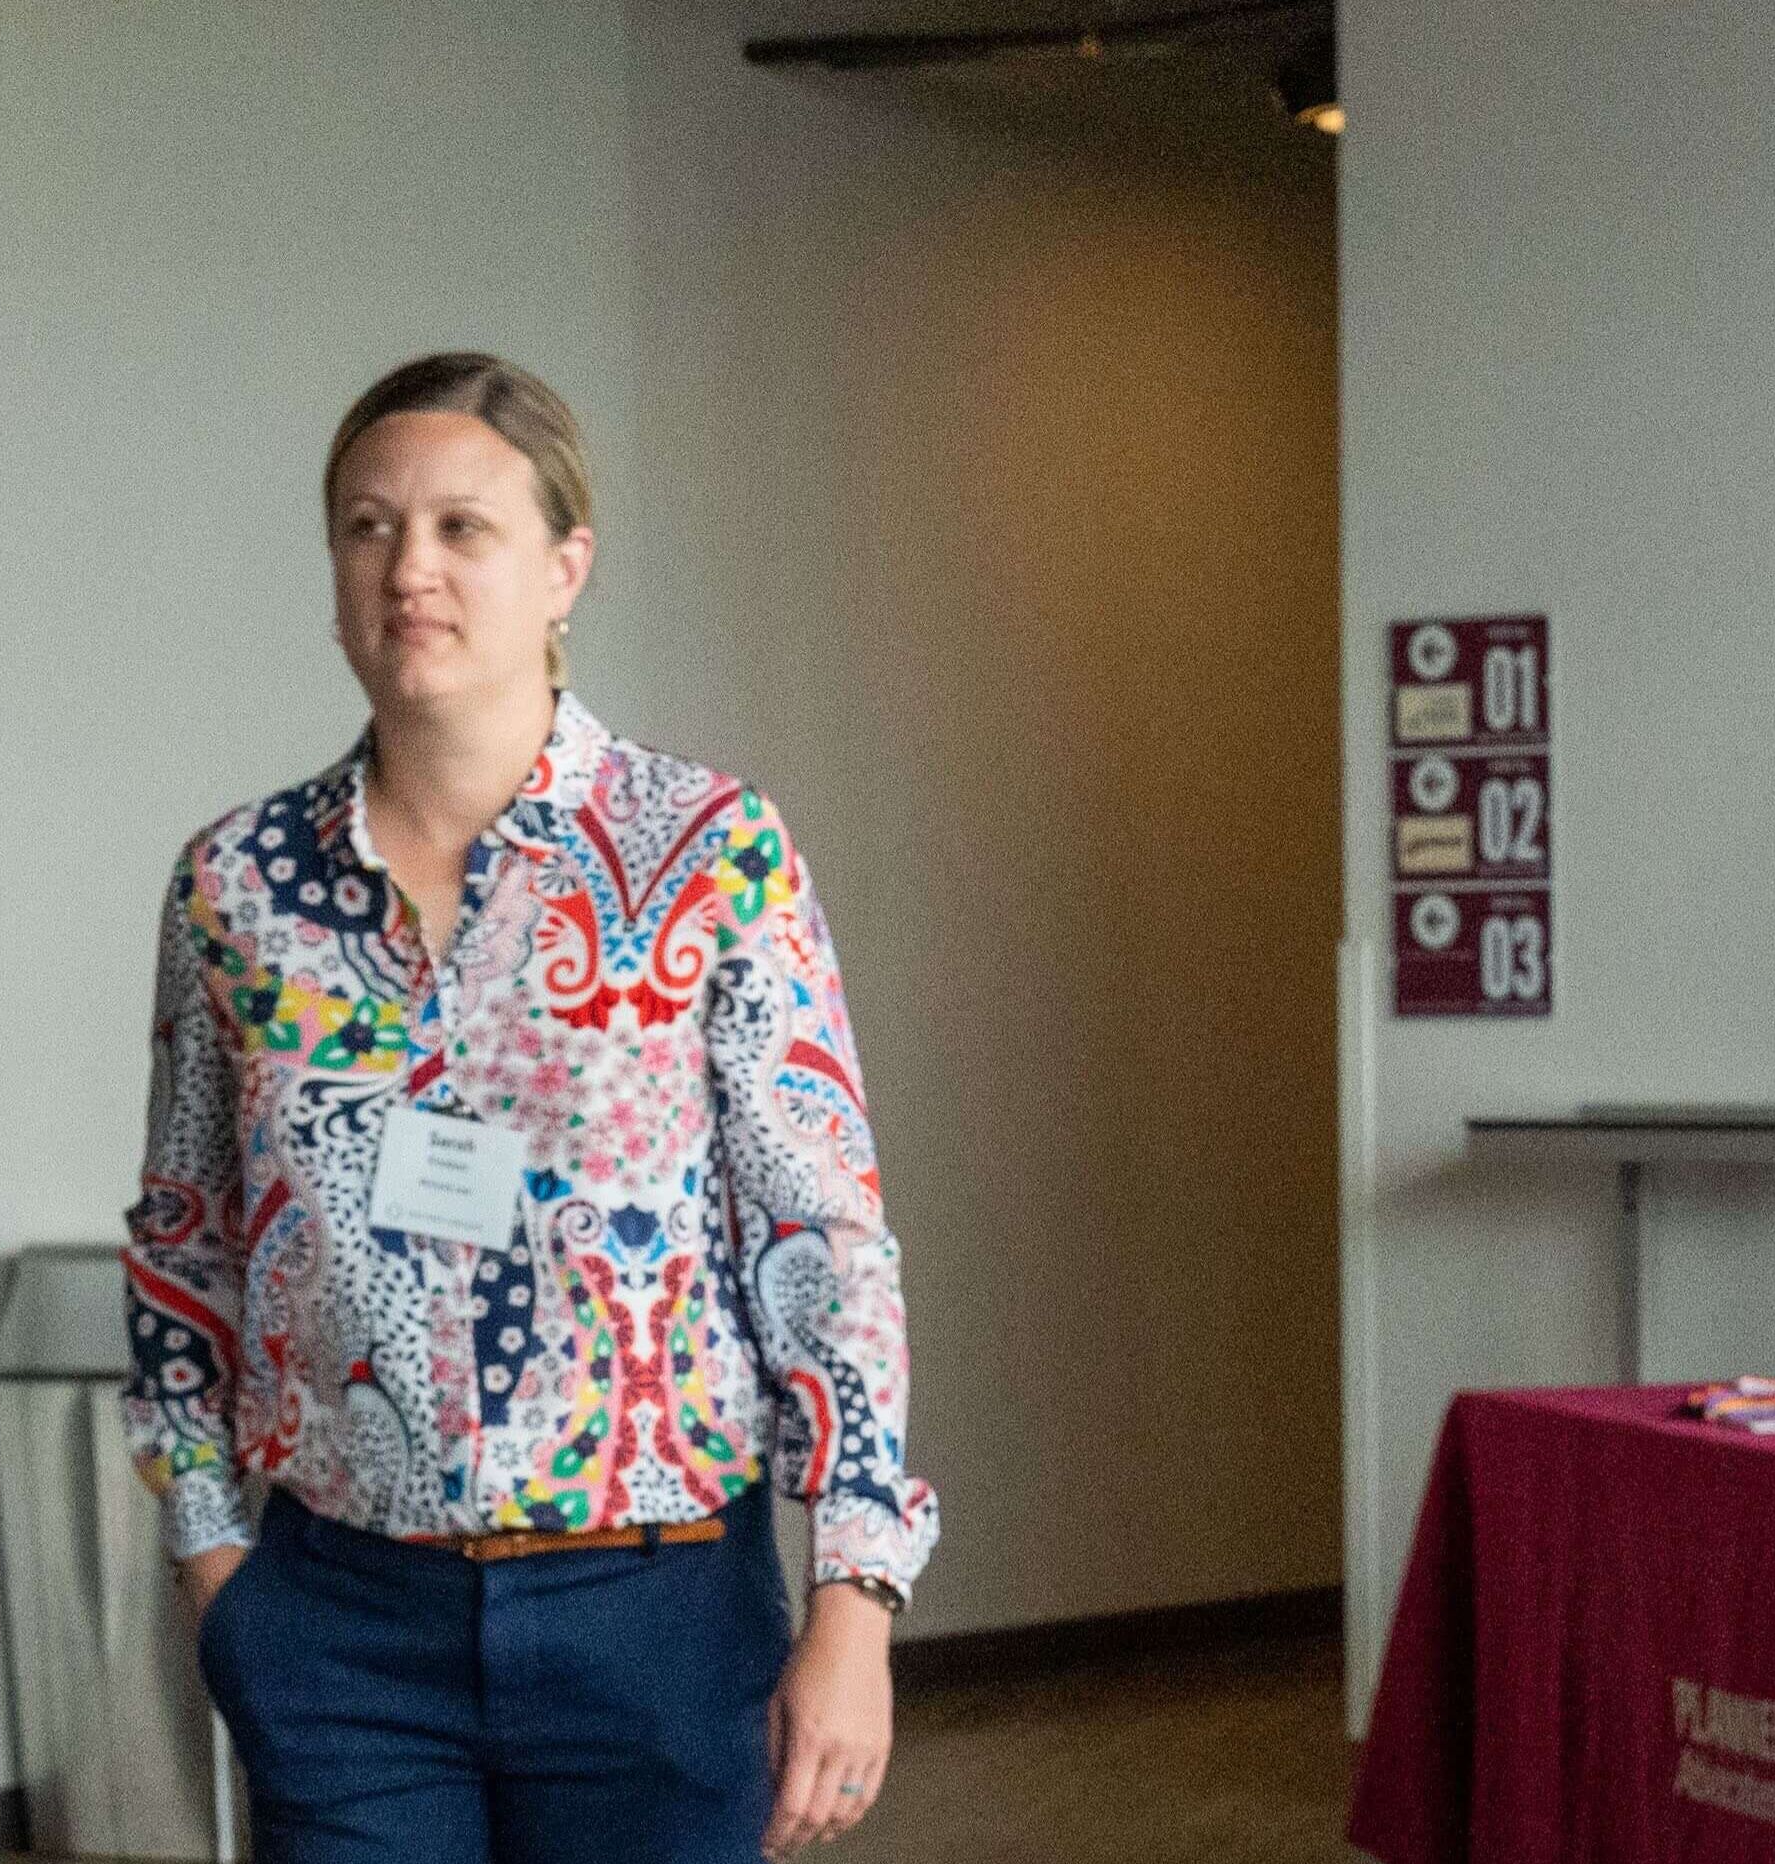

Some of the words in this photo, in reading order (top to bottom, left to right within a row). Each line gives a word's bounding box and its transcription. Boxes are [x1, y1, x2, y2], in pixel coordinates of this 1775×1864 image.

[1483, 646, 1539, 729] 01
[1478, 778, 1543, 862] 02
[1480, 916, 1544, 1000] 03
